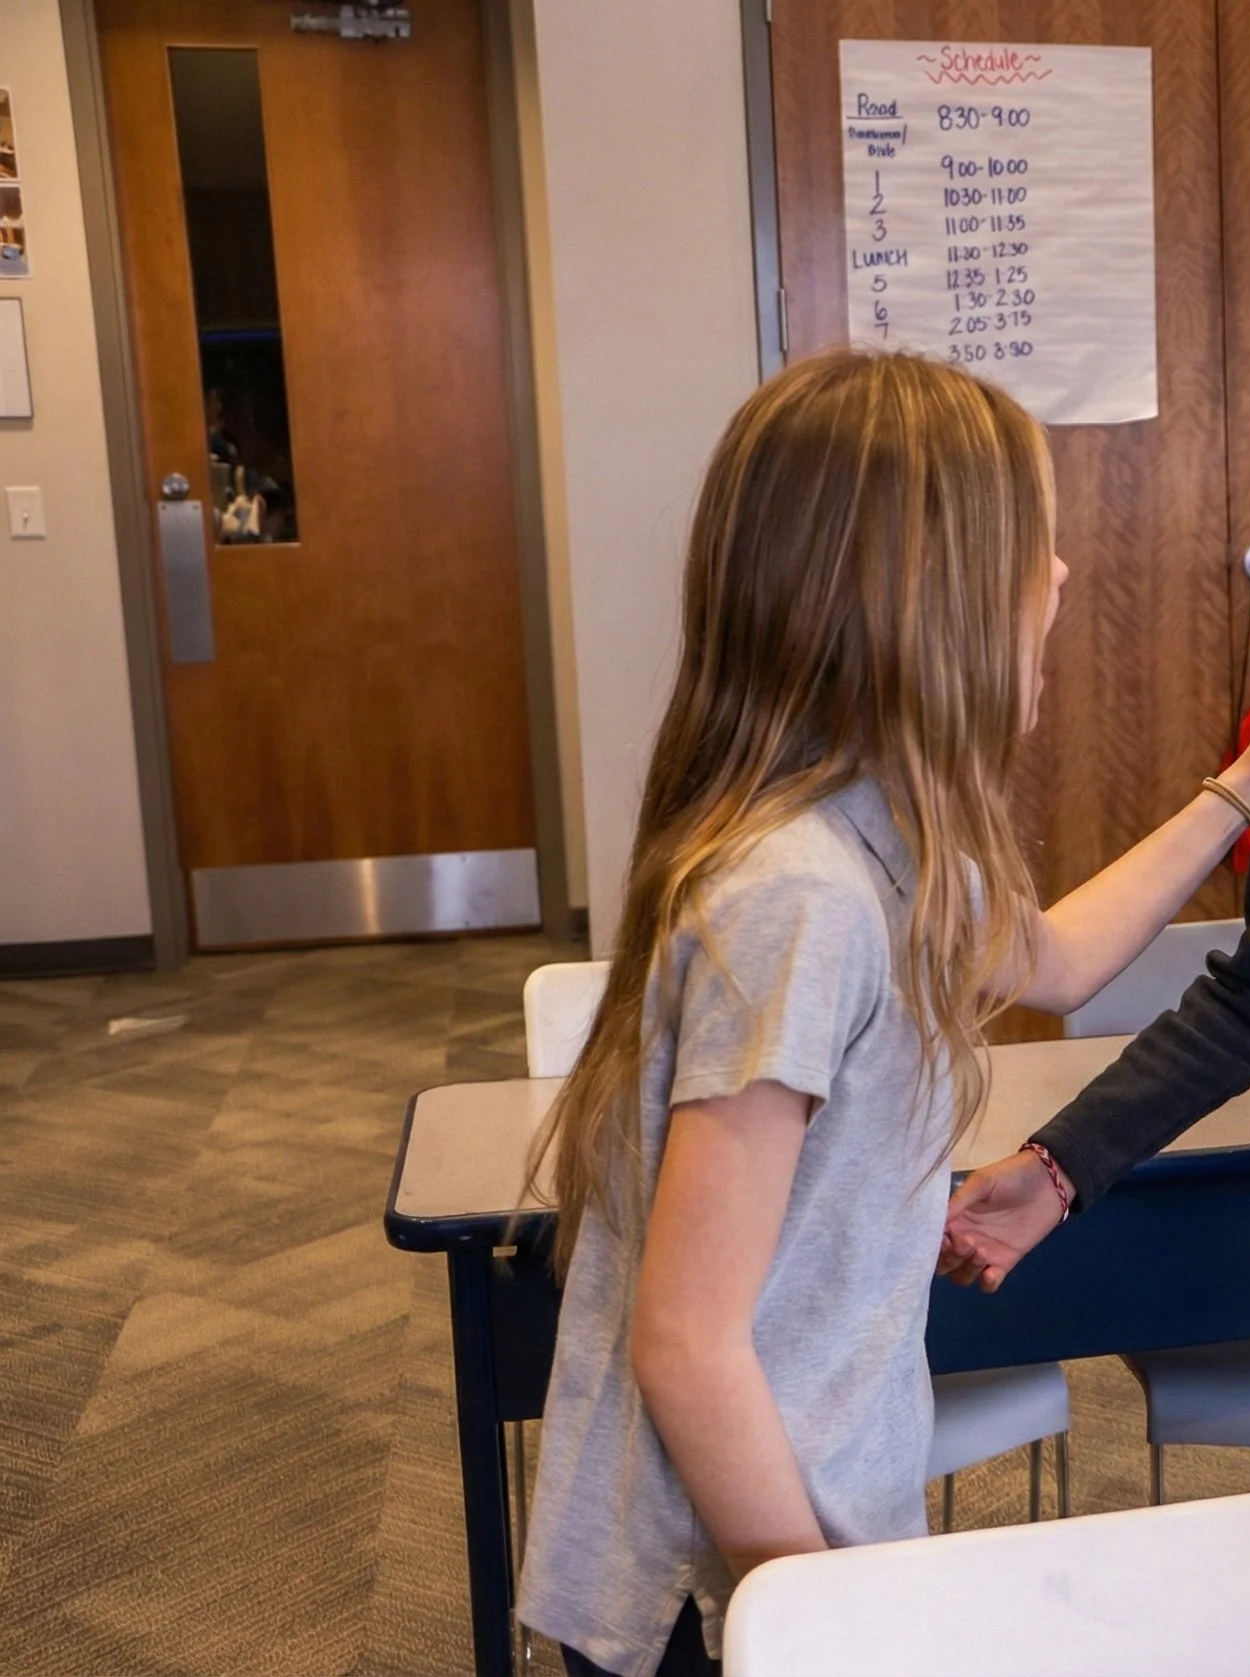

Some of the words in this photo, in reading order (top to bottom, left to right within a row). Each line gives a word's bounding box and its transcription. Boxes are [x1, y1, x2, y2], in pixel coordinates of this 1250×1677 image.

[869, 194, 887, 215] 2
[872, 219, 887, 242] 3
[853, 249, 907, 269] LUNCH
[871, 275, 887, 292] 5
[874, 300, 887, 322] 6
